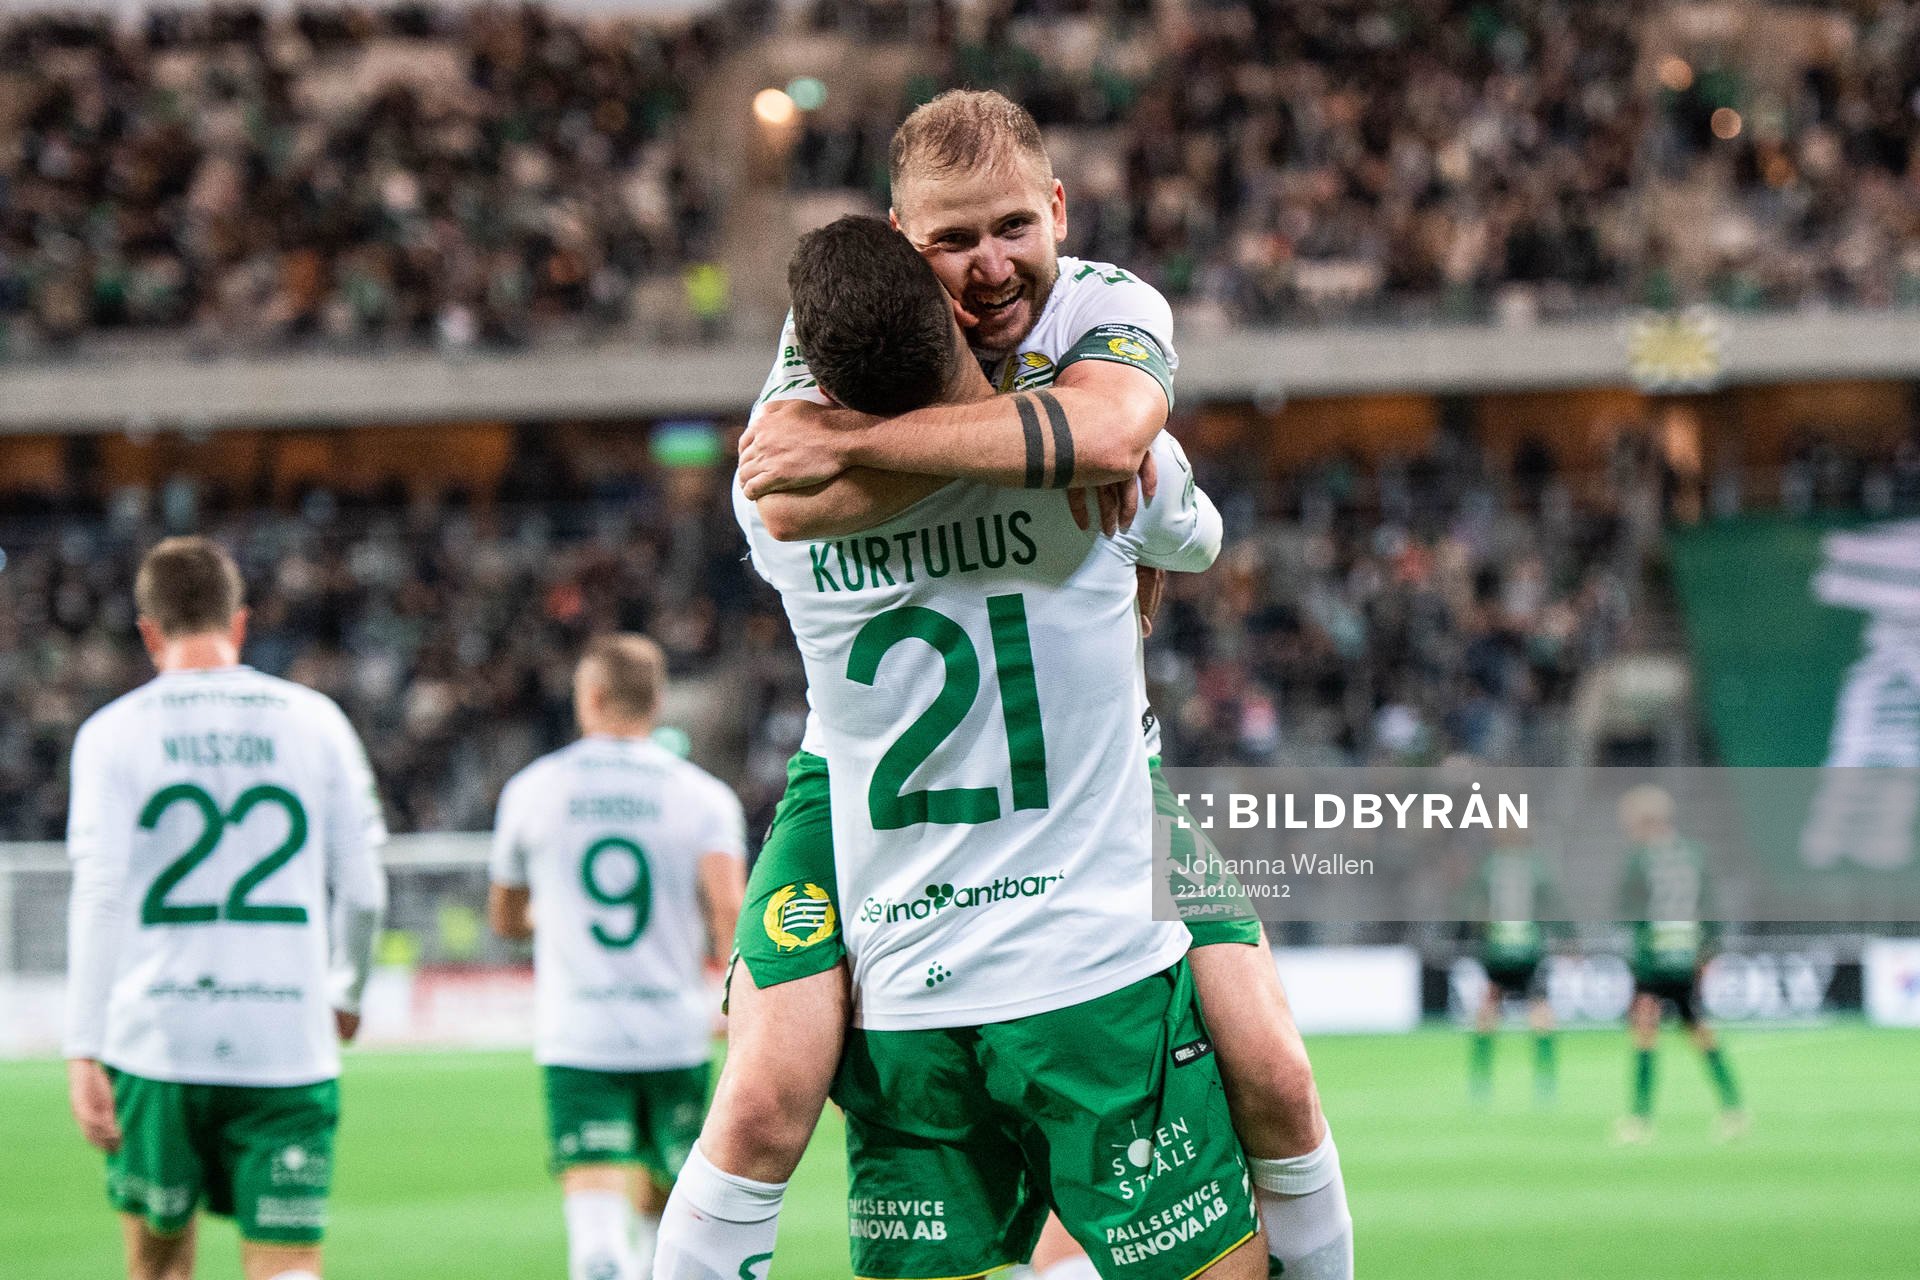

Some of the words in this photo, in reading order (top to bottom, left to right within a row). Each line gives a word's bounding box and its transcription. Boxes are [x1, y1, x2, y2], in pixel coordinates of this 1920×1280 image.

[809, 510, 1037, 593] KURTULUS
[845, 594, 1049, 831] 21
[138, 783, 309, 927] 22
[579, 836, 654, 951] 9
[1179, 904, 1233, 918] CRAFT
[1119, 1139, 1196, 1199] STÅLE
[912, 1220, 947, 1240] AB
[1106, 1180, 1220, 1244] PALLSERVICE
[1110, 1216, 1205, 1266] RENOVA
[1203, 1196, 1228, 1227] AB
